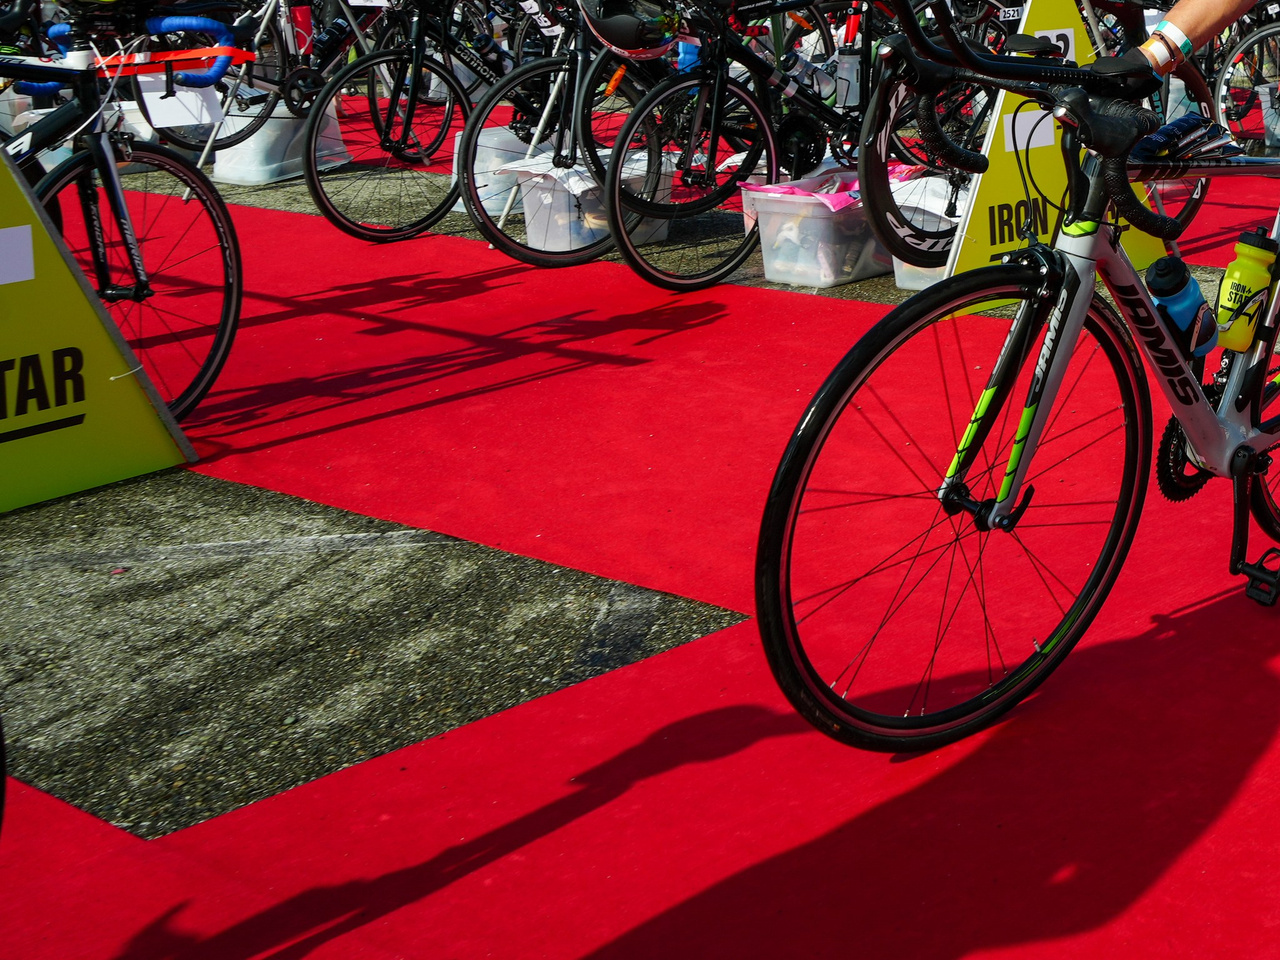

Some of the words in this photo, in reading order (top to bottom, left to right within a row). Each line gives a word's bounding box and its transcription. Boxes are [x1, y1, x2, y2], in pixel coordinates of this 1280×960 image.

[1003, 9, 1020, 19] 2521
[1038, 33, 1070, 59] 2
[988, 197, 1049, 246] IRON
[1230, 281, 1247, 294] IRON
[1035, 288, 1068, 393] JAMIS
[1100, 267, 1201, 407] JAMIS
